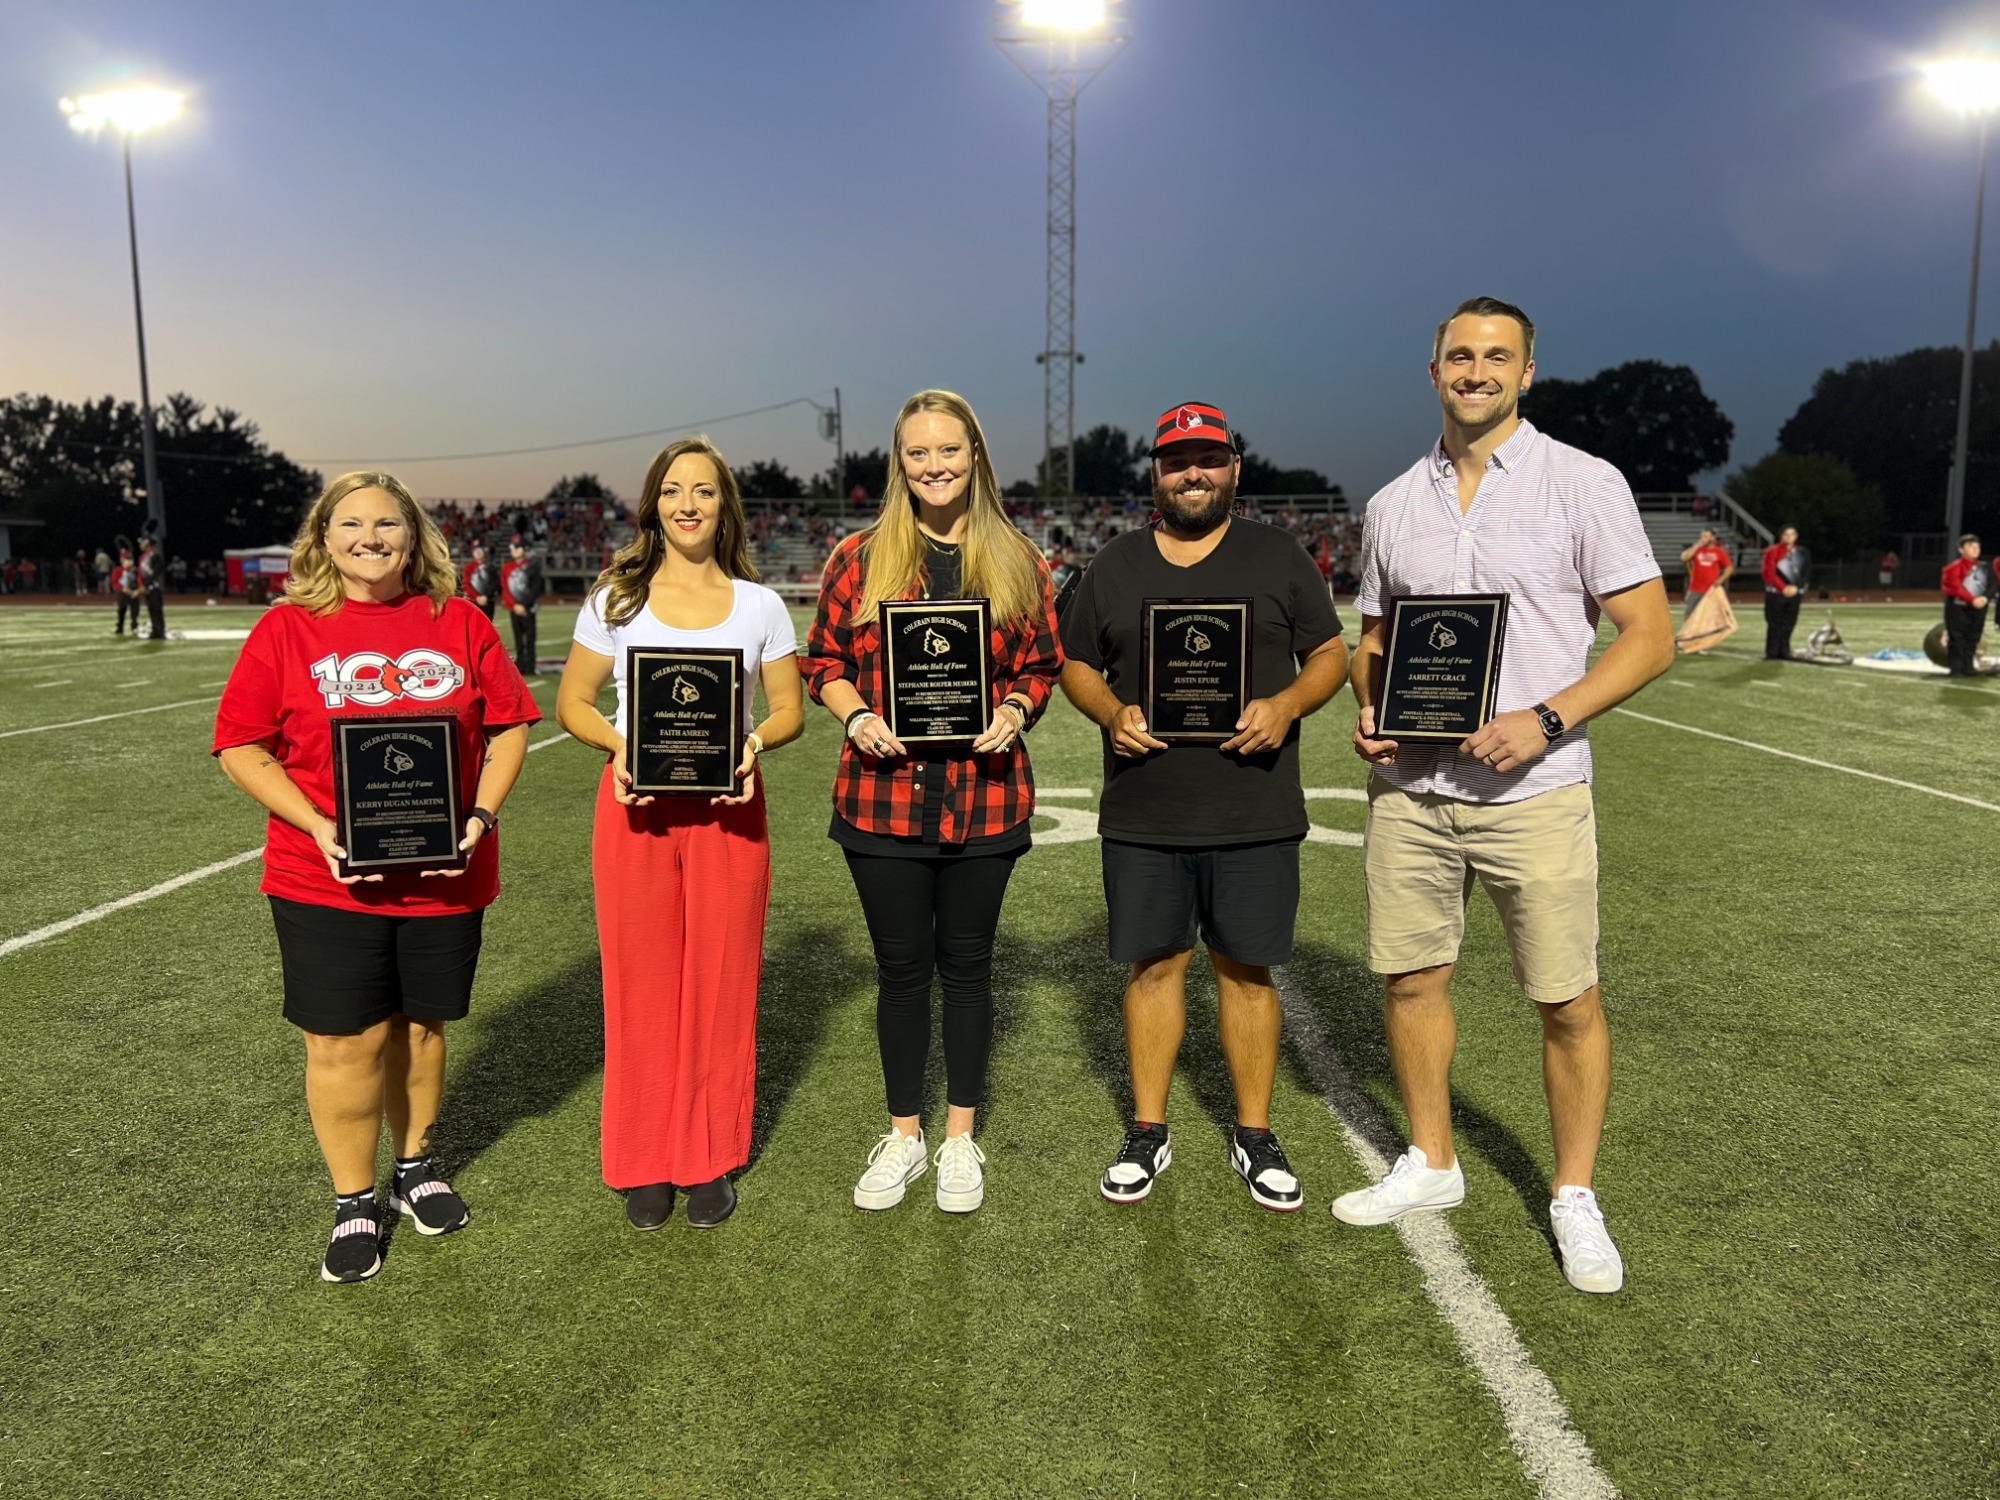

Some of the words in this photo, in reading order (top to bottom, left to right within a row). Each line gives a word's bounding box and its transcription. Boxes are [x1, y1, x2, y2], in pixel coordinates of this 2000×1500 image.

[903, 618, 930, 634] COLERAIN
[946, 618, 968, 633] SCHOOL
[1165, 615, 1193, 631] COLERAIN
[1208, 616, 1230, 632] SCHOOL
[1410, 611, 1440, 627] COLERAIN
[1457, 611, 1480, 628] SCHOOL
[944, 663, 951, 671] of
[1408, 656, 1431, 664] Athletic
[1432, 656, 1446, 664] Hall
[1447, 657, 1455, 666] of
[311, 648, 457, 708] 100
[418, 667, 457, 678] 2024
[651, 665, 681, 681] COLERAIN
[697, 666, 719, 683] SCHOOL
[335, 683, 376, 693] 1924
[418, 706, 461, 716] SCHOOL
[692, 712, 700, 720] of
[360, 733, 391, 751] COLERAIN
[409, 734, 434, 749] SCHOOL
[365, 782, 390, 790] Athletic
[407, 781, 415, 790] of
[356, 801, 383, 809] KERRY
[384, 800, 410, 808] DUGAN
[412, 798, 444, 806] MARTINI
[409, 1181, 453, 1204] PUMA
[331, 1218, 376, 1243] PUMA
